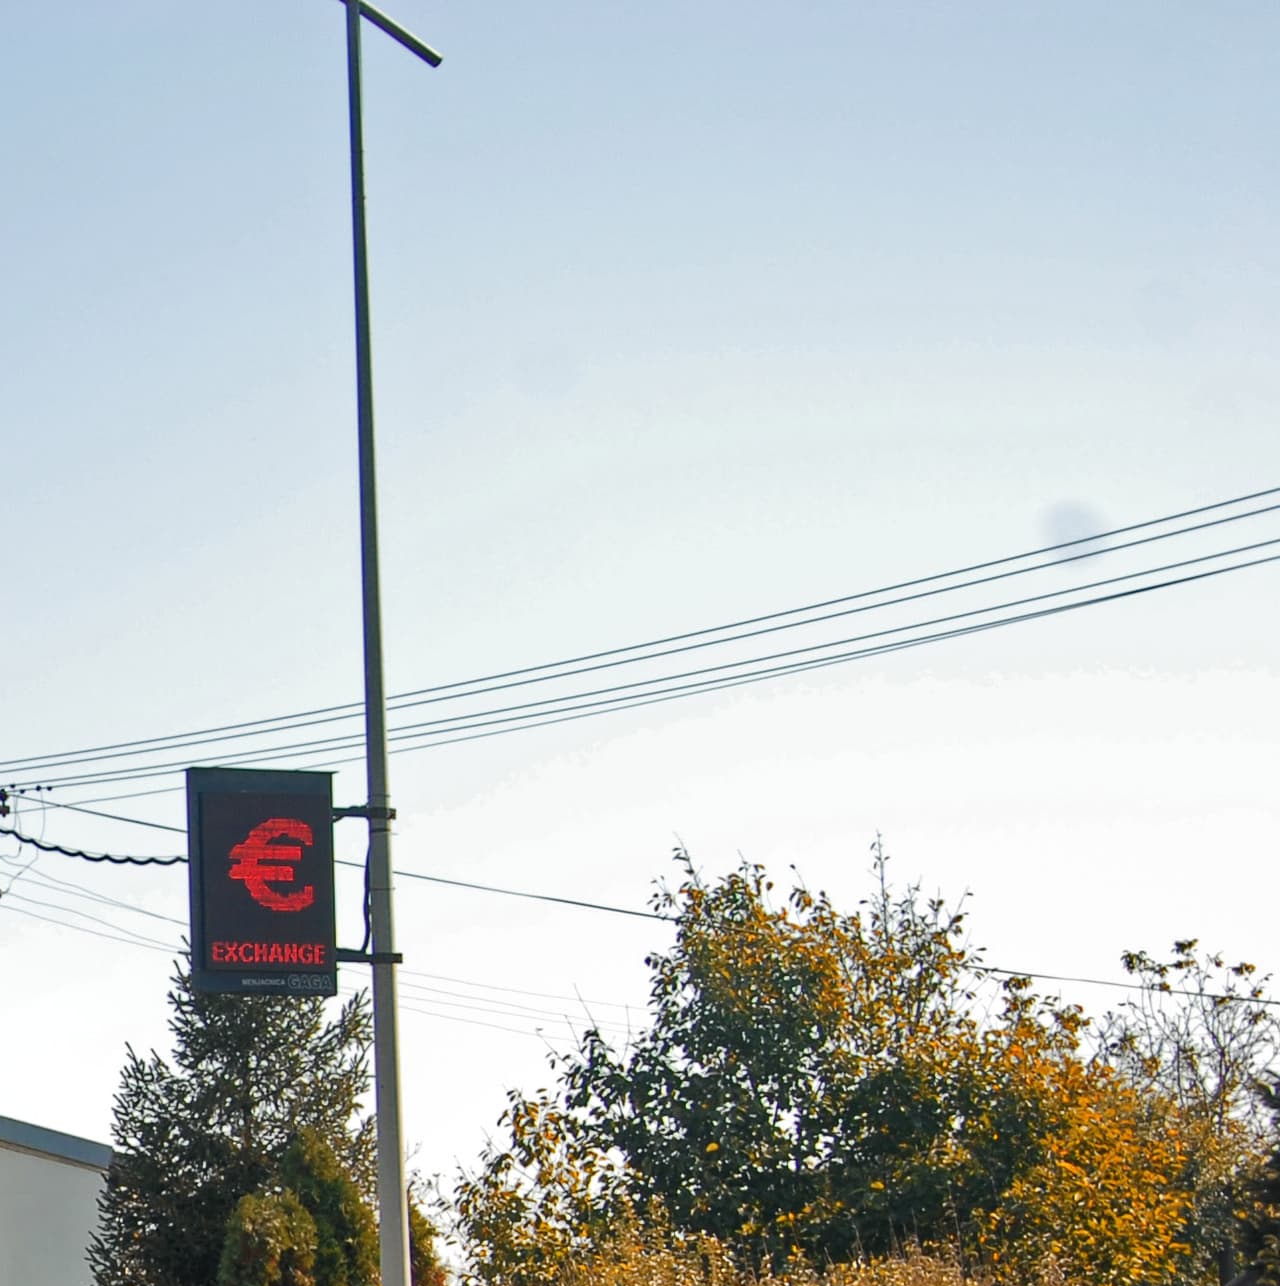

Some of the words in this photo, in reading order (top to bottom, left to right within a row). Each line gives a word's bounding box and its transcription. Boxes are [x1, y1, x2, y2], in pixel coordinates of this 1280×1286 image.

[228, 818, 314, 911] €
[211, 942, 327, 965] EXCHANGE
[288, 973, 333, 990] GAGA
